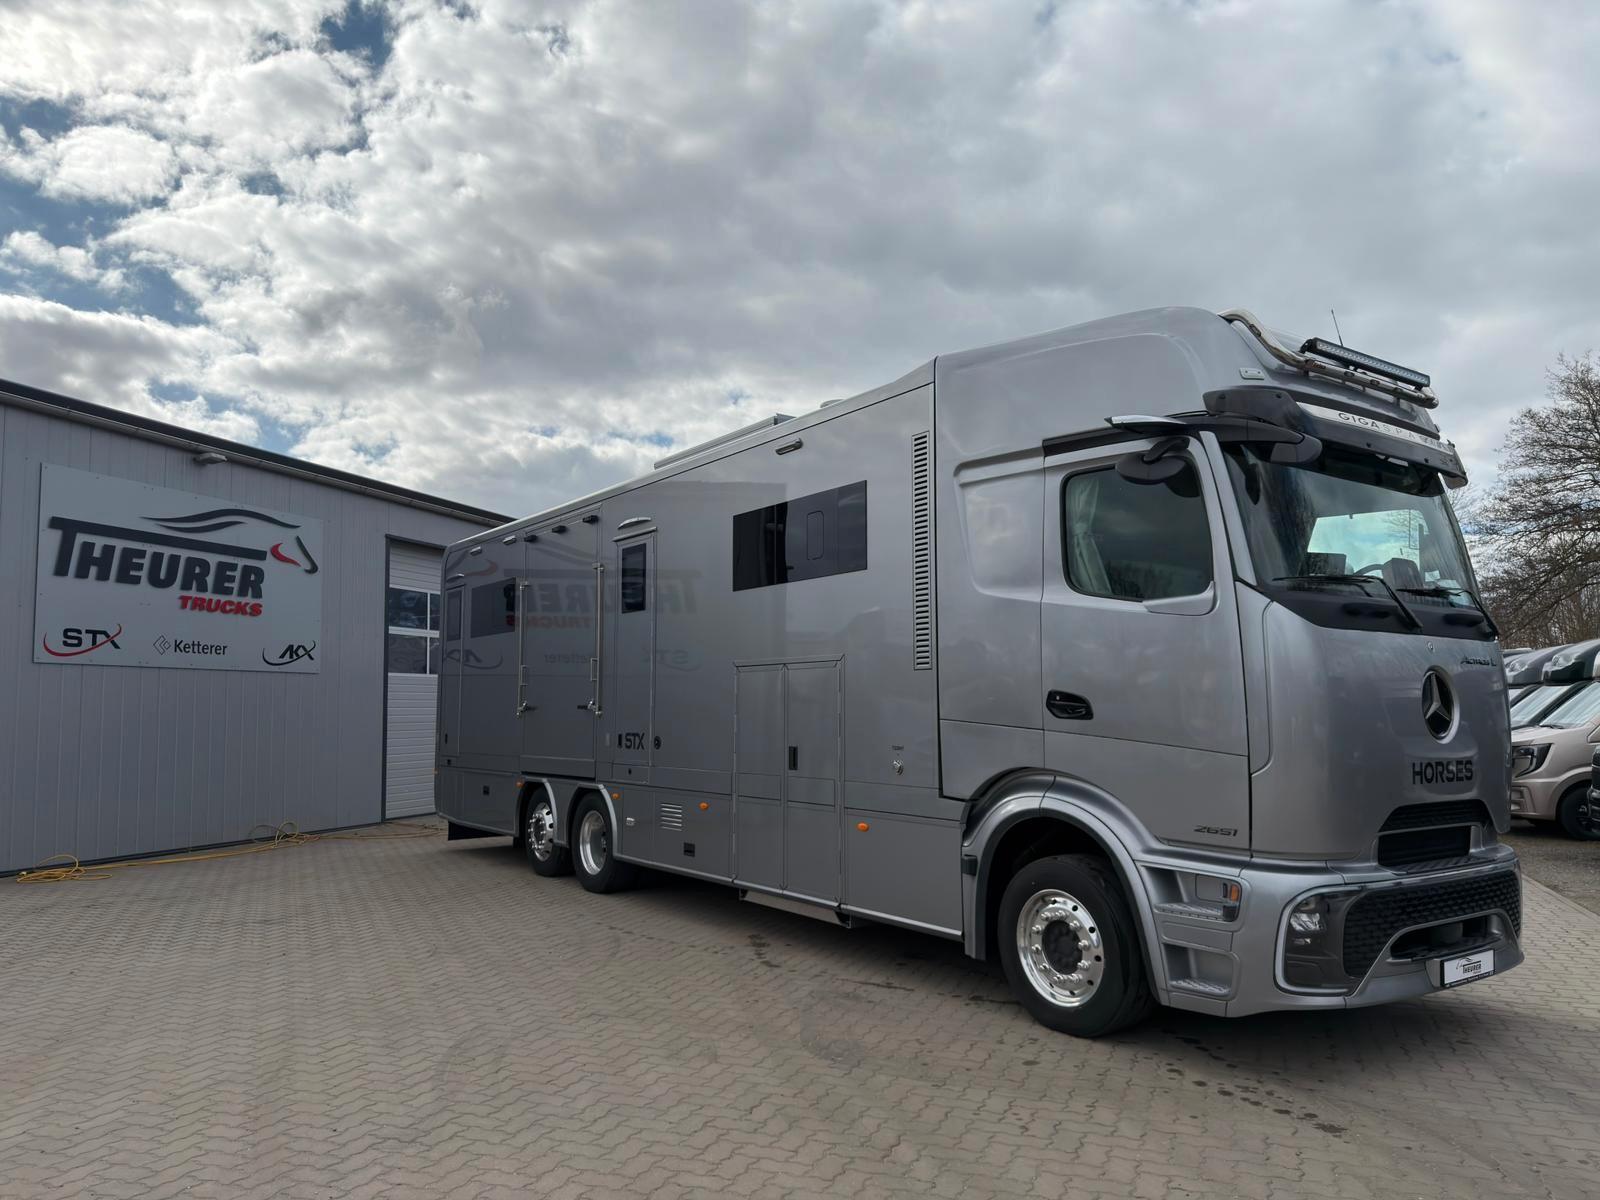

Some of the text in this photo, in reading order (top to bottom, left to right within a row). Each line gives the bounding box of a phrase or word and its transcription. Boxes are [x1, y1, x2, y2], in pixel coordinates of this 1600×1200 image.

[48, 516, 268, 599] THEURER
[178, 595, 263, 616] TRUCKS
[62, 624, 122, 650] STX
[174, 639, 228, 656] Ketterer
[625, 732, 645, 750] STX
[1412, 760, 1473, 784] HORSES
[1193, 825, 1238, 837] 2651
